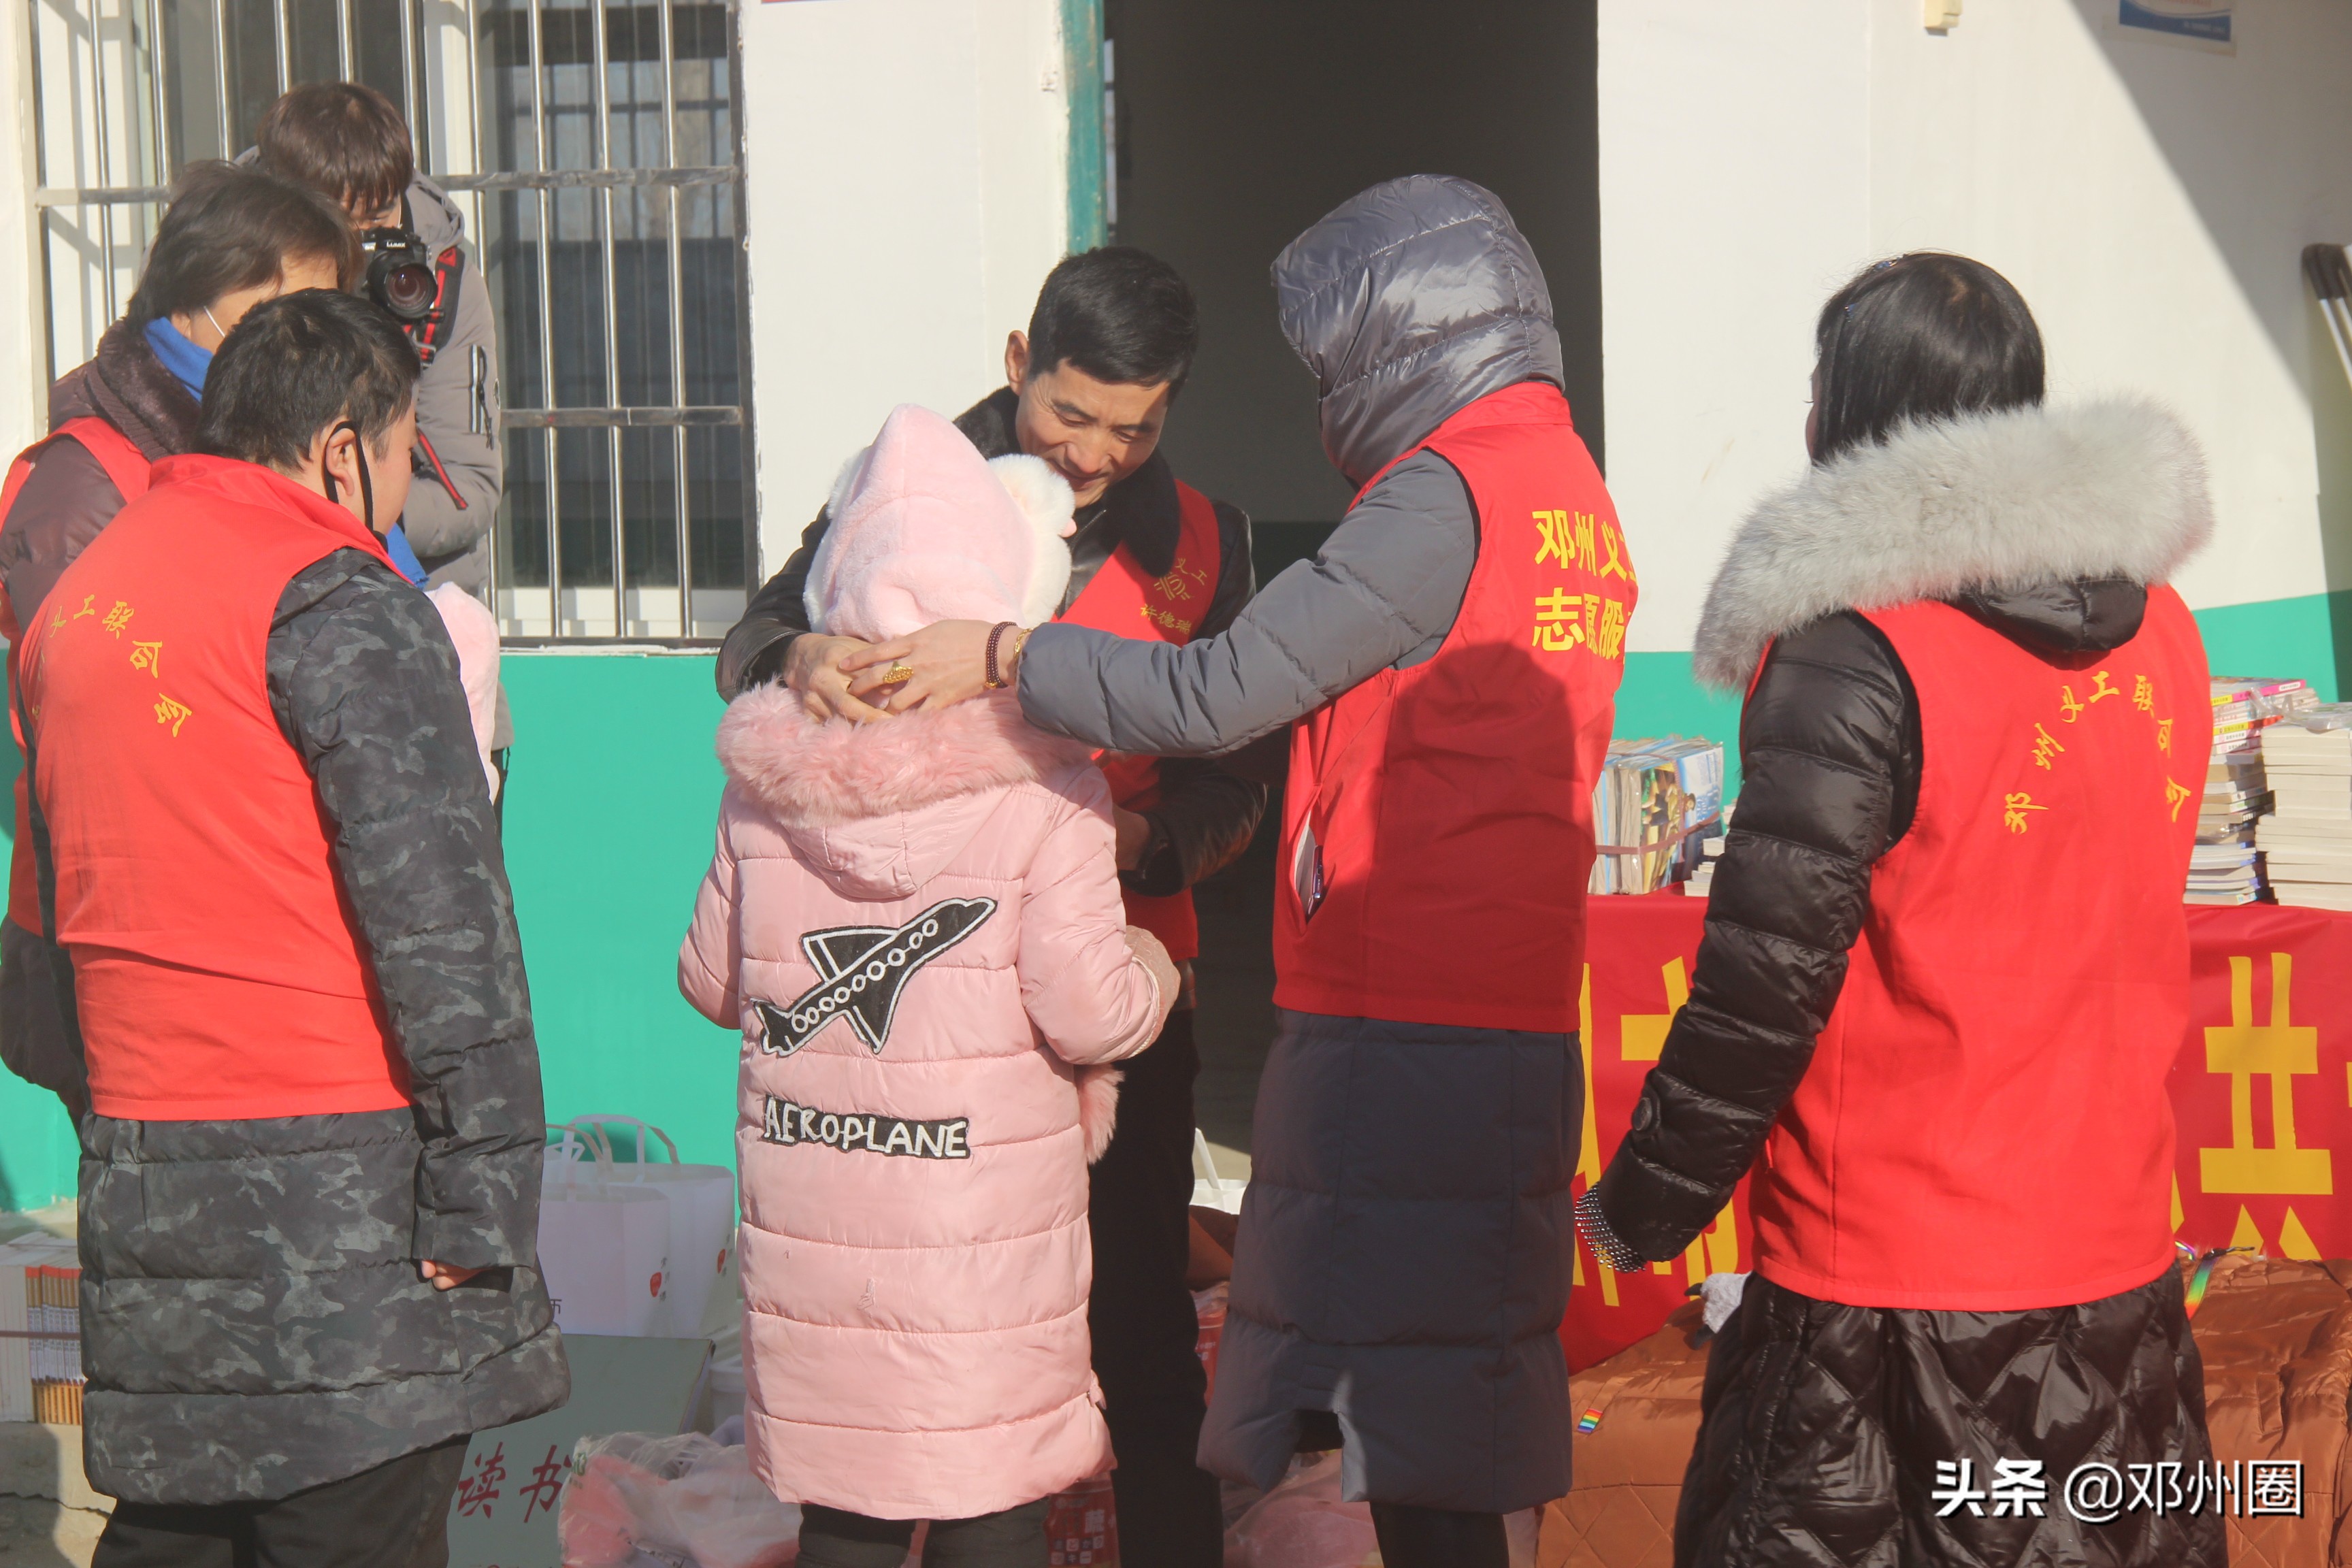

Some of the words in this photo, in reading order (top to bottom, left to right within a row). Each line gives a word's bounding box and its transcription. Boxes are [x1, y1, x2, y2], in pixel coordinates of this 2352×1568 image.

[32, 593, 193, 739] 义工联合会
[1531, 587, 1632, 665] 志愿服
[764, 1097, 967, 1158] AEROPLANE
[457, 1441, 573, 1524] 读书
